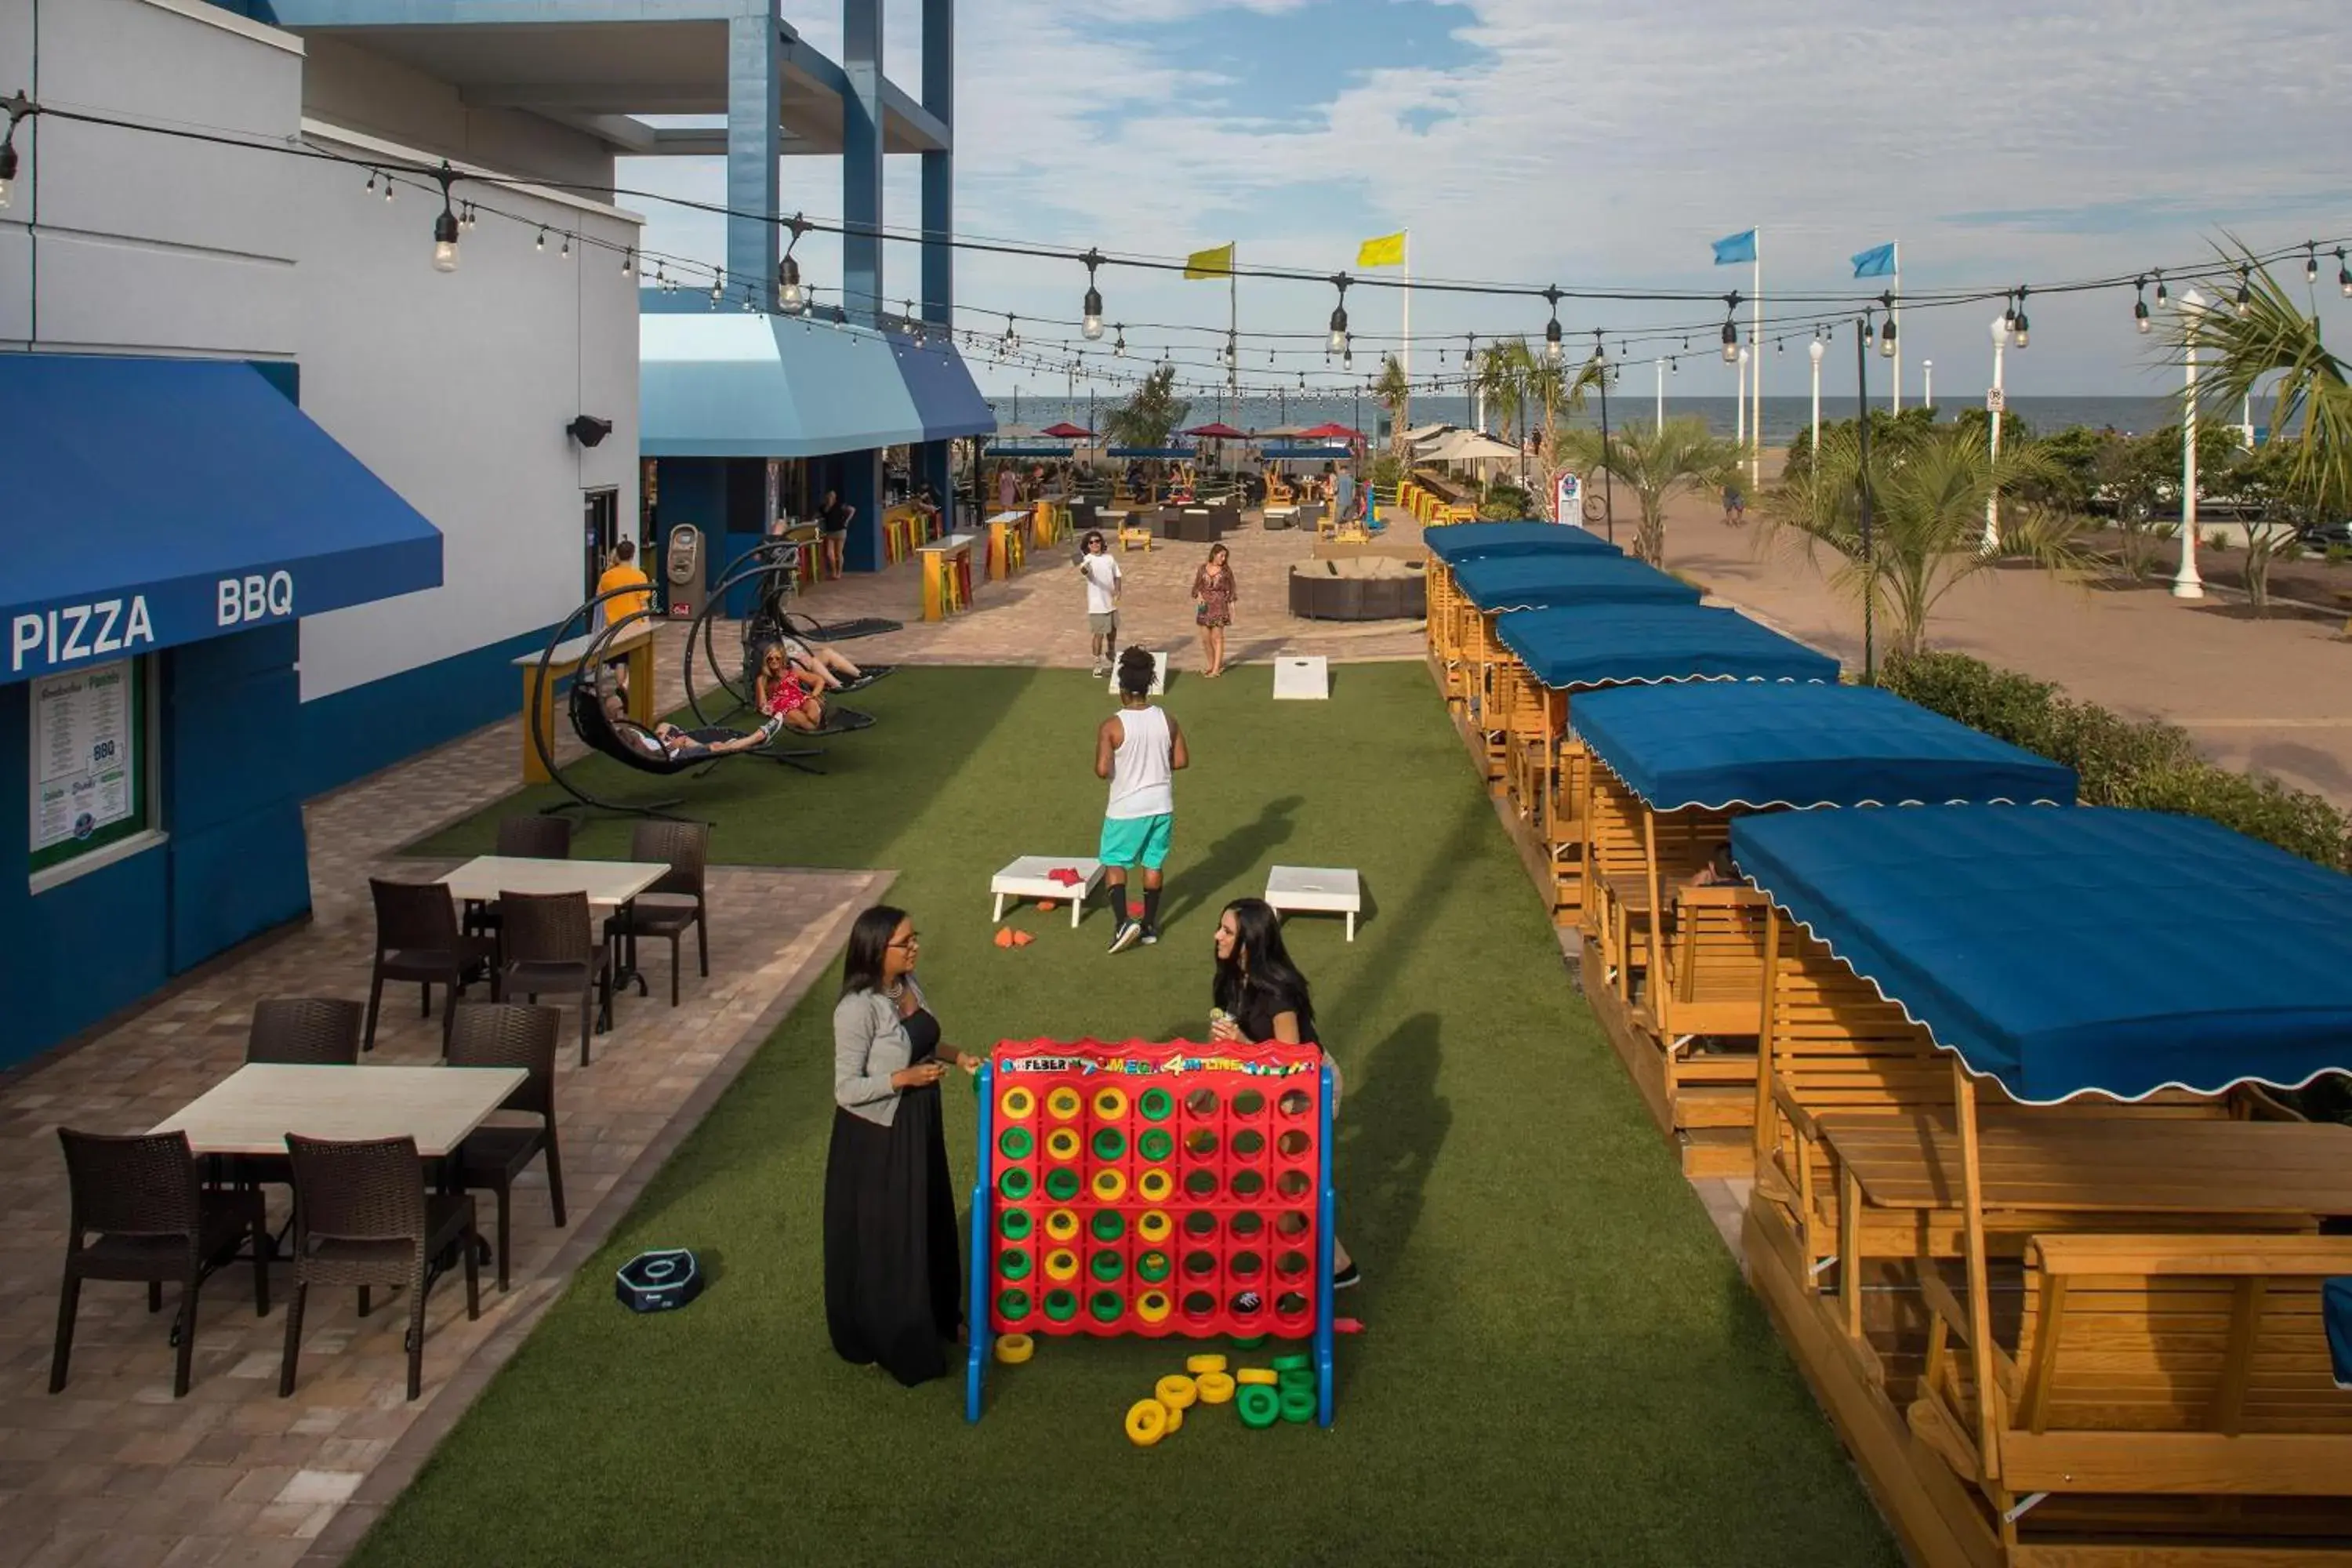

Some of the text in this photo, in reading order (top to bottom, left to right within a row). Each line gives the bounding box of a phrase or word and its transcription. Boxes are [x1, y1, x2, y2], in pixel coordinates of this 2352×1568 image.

[217, 570, 294, 626] BBQ
[12, 595, 154, 672] PIZZA
[1025, 1060, 1068, 1070] FEBER
[1160, 1053, 1184, 1078] 4
